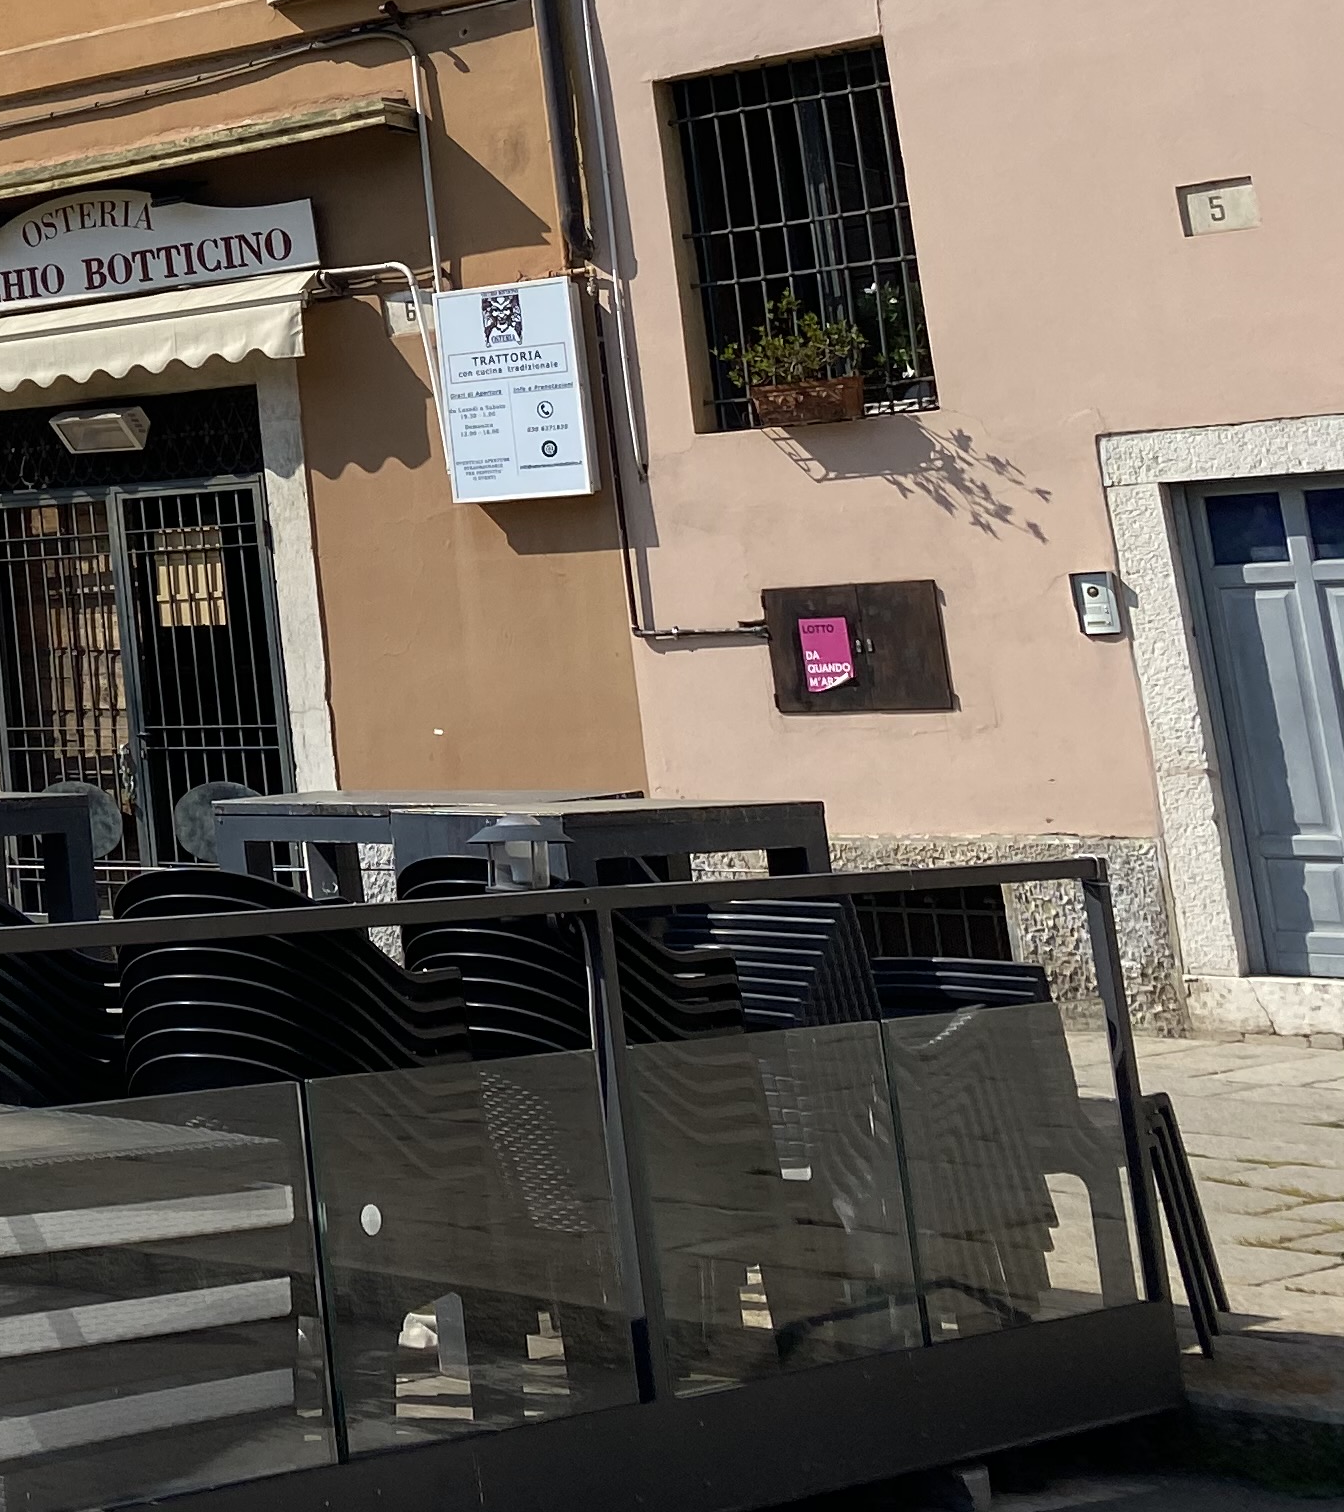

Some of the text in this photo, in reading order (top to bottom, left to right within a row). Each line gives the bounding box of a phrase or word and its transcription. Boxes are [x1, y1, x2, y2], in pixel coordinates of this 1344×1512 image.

[1208, 196, 1225, 221] 5
[21, 199, 155, 248] OSTERIA
[83, 227, 293, 292] BOTTICINO
[471, 350, 542, 367] TRATTORIA
[458, 361, 559, 378] con cucina tradizionale
[802, 623, 834, 634] LOTTO
[805, 650, 820, 661] DA
[807, 662, 851, 673] QUANDO
